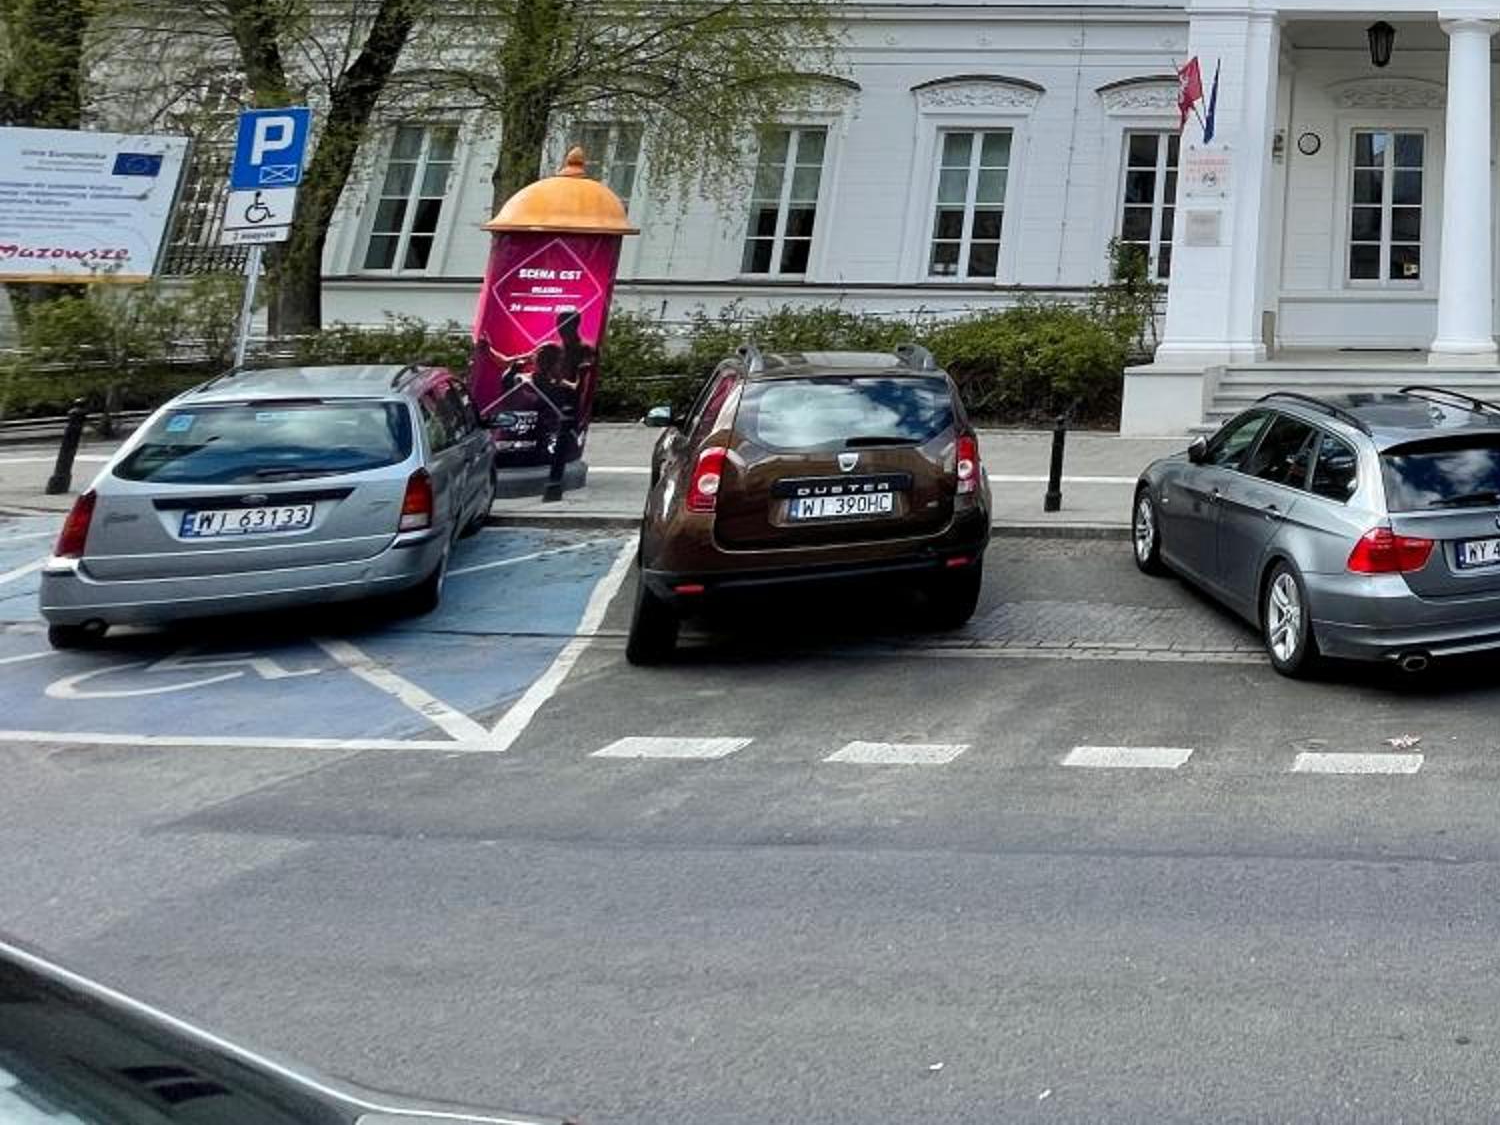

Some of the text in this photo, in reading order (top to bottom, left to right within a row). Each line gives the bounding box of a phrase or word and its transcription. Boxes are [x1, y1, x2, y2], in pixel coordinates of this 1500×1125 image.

[250, 116, 295, 166] P
[518, 268, 555, 280] SCENA
[797, 482, 890, 495] DUSTER
[803, 495, 889, 516] WI 390HC
[199, 507, 308, 530] WI 63133
[1468, 543, 1487, 561] WY
